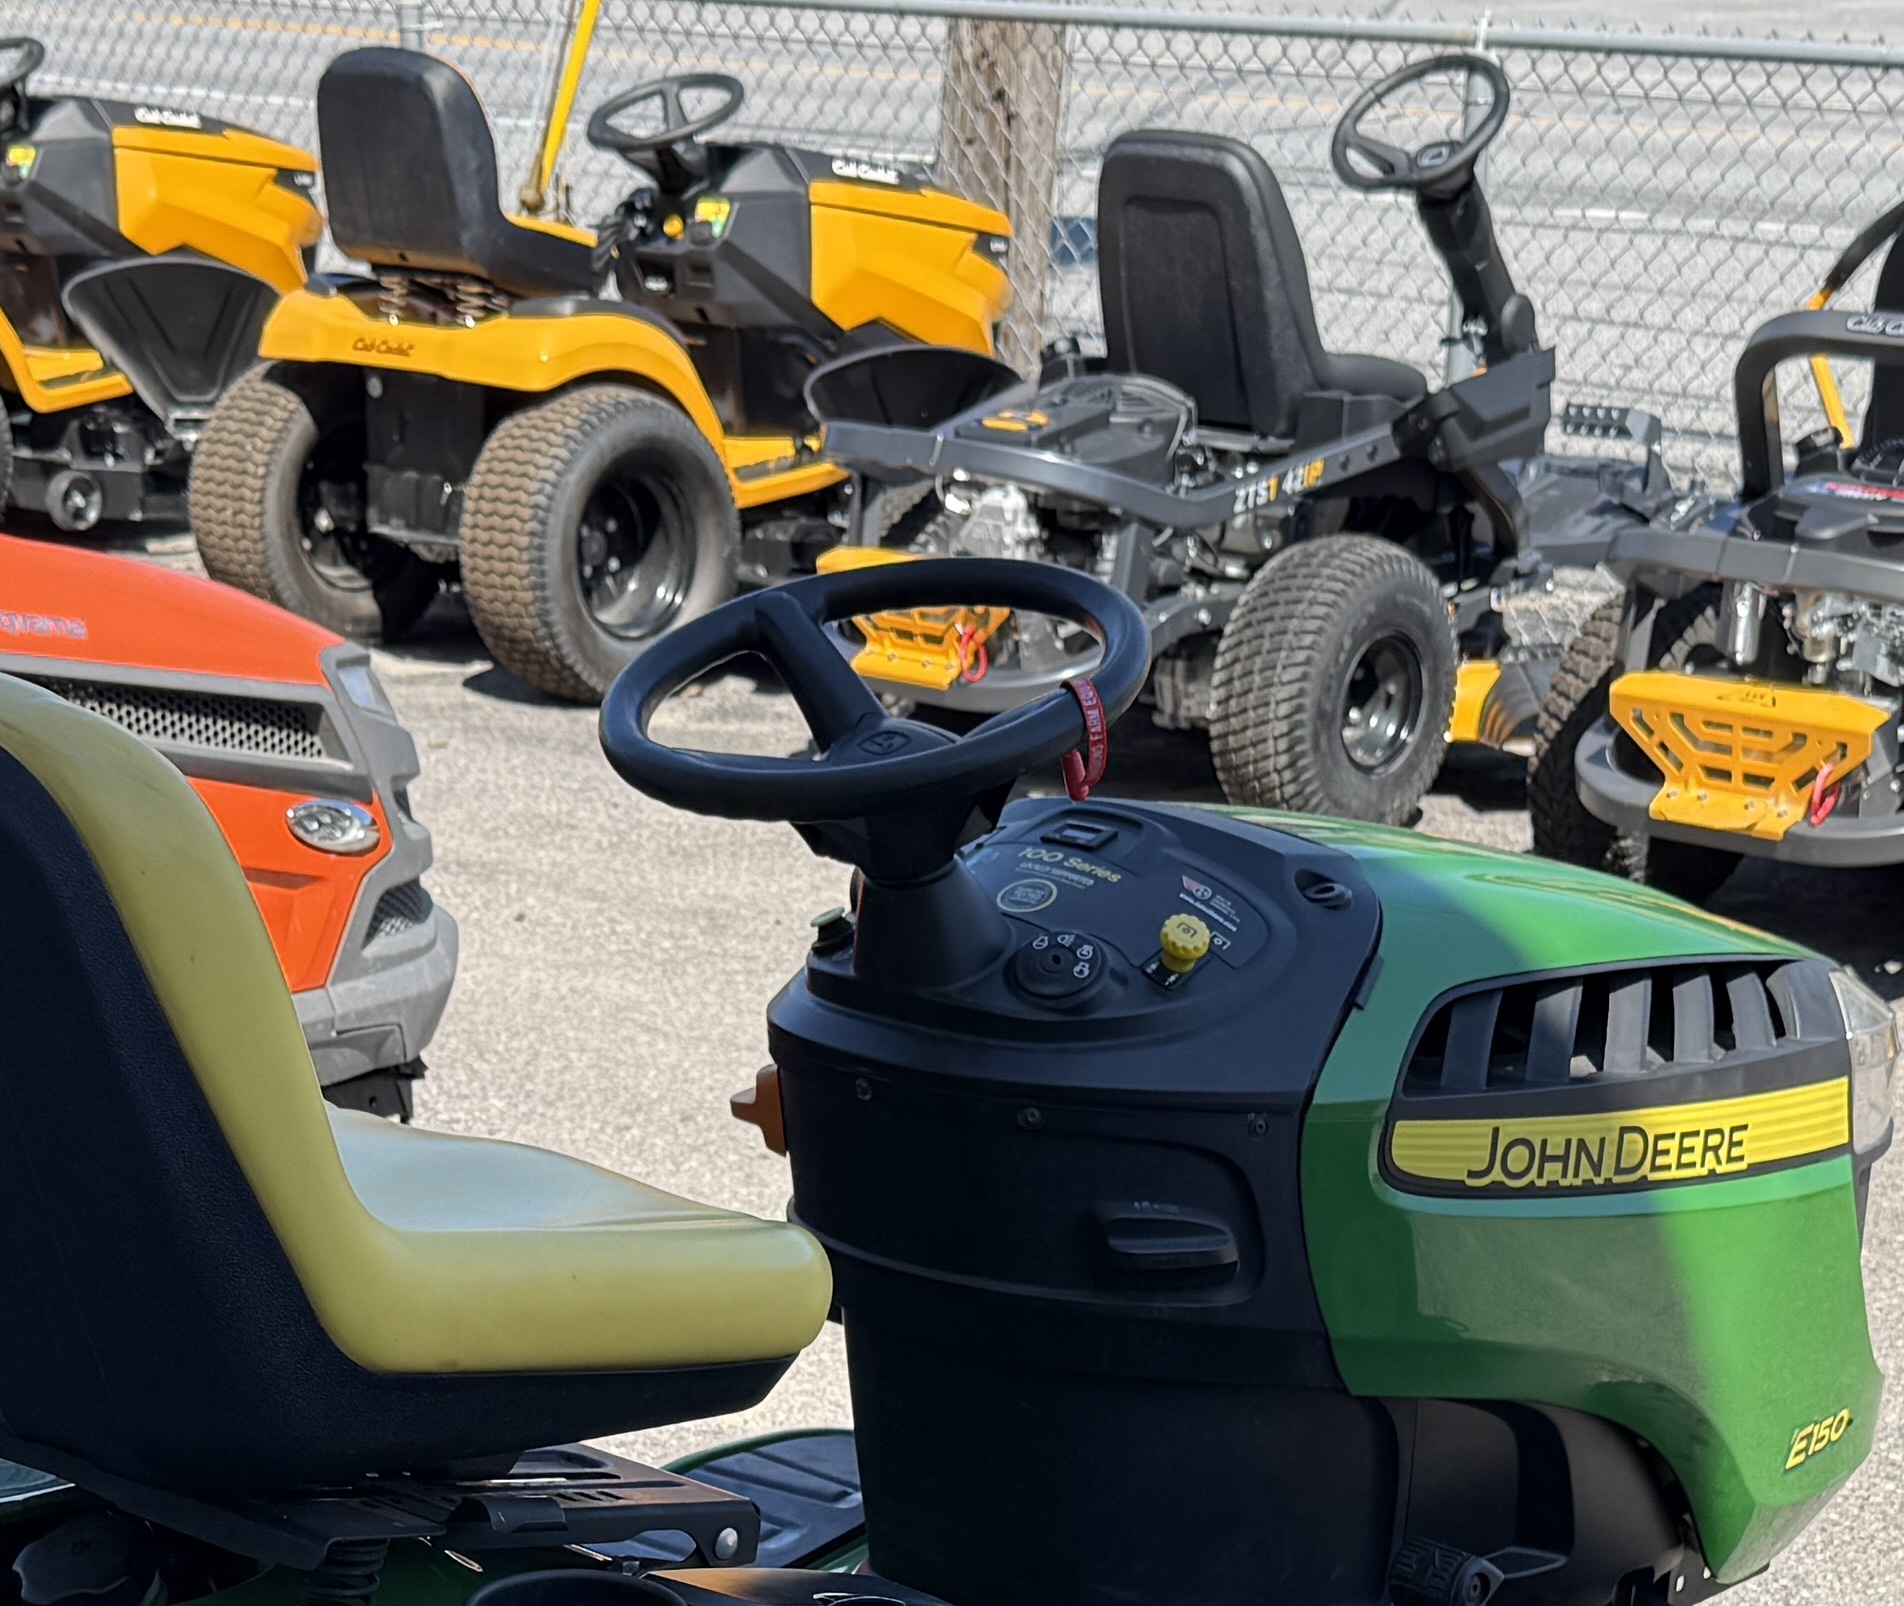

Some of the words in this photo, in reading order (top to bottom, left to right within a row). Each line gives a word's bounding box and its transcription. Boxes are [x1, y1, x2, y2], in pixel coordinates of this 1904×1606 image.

[1233, 474, 1280, 514] ZTS1
[1086, 709, 1103, 740] FARM
[1018, 847, 1064, 862] 100
[1063, 857, 1122, 883] Series
[1466, 1125, 1607, 1181] JOHN
[1612, 1123, 1749, 1177] DEERE
[1785, 1408, 1853, 1471] E150
